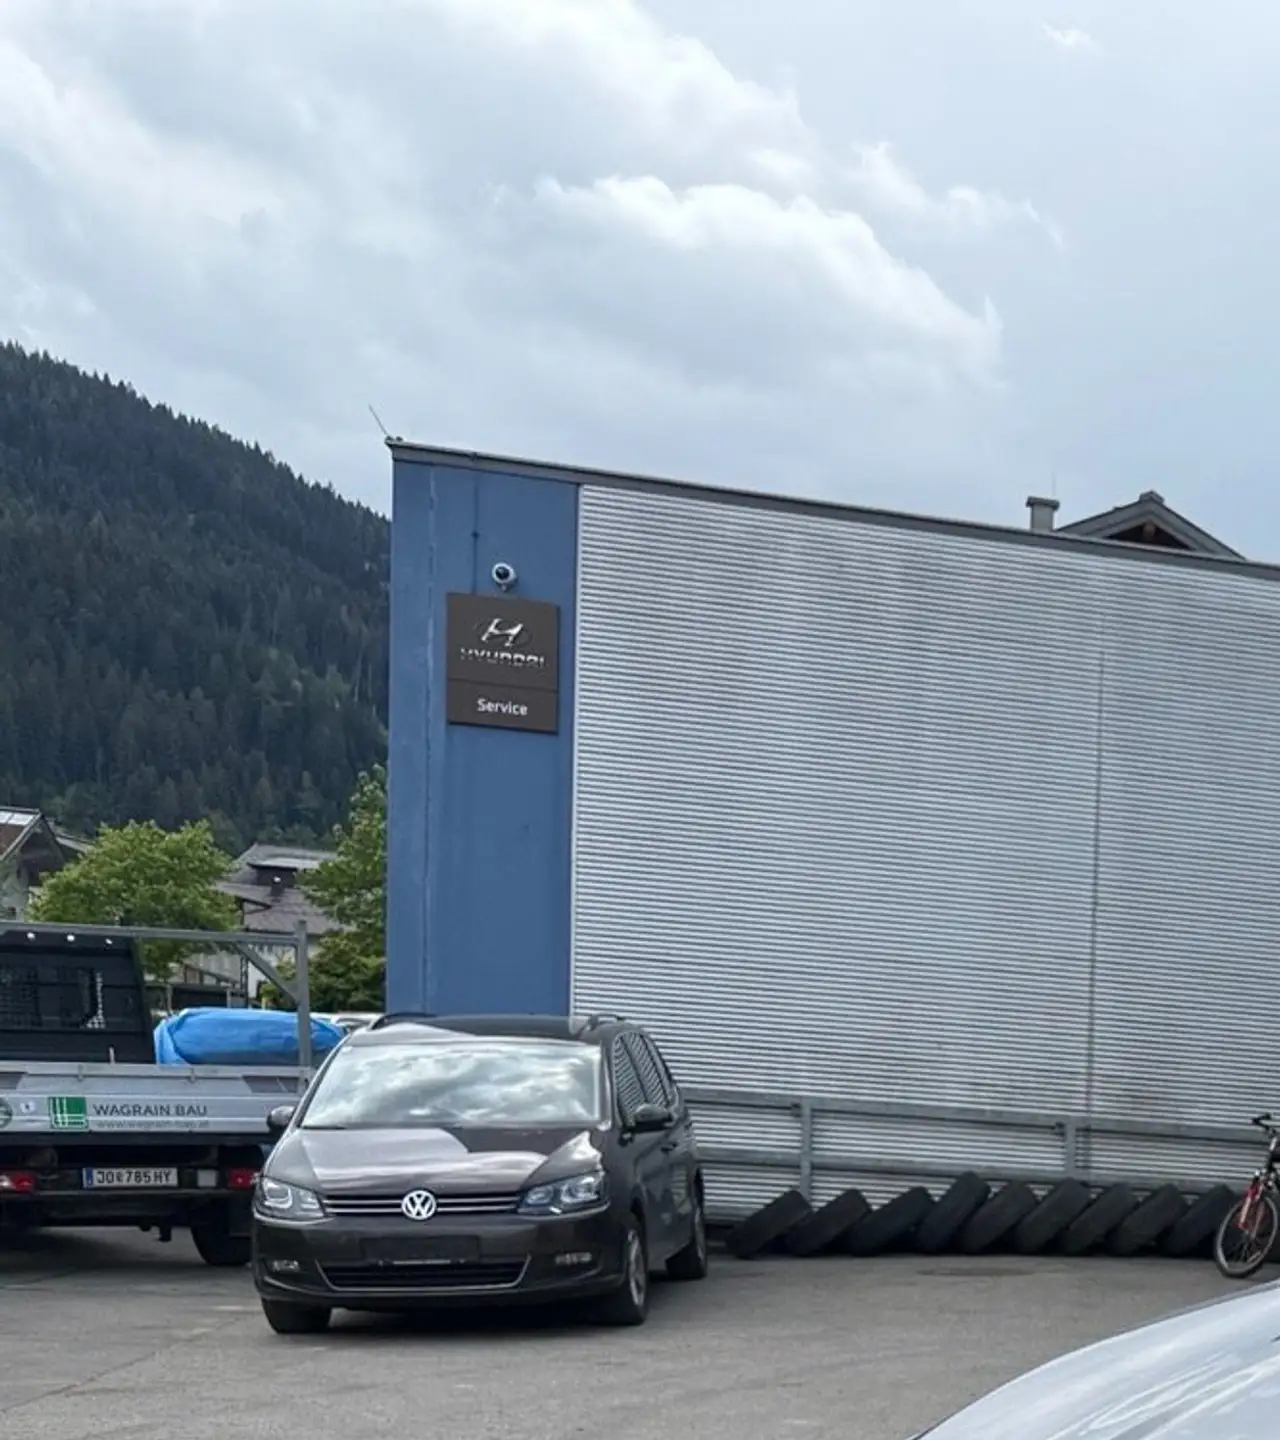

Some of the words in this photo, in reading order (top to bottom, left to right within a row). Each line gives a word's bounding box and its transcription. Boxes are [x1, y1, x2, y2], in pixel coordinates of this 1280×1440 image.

[477, 697, 528, 716] Service
[92, 1103, 170, 1116] WAGRAIN
[175, 1104, 208, 1117] BAU
